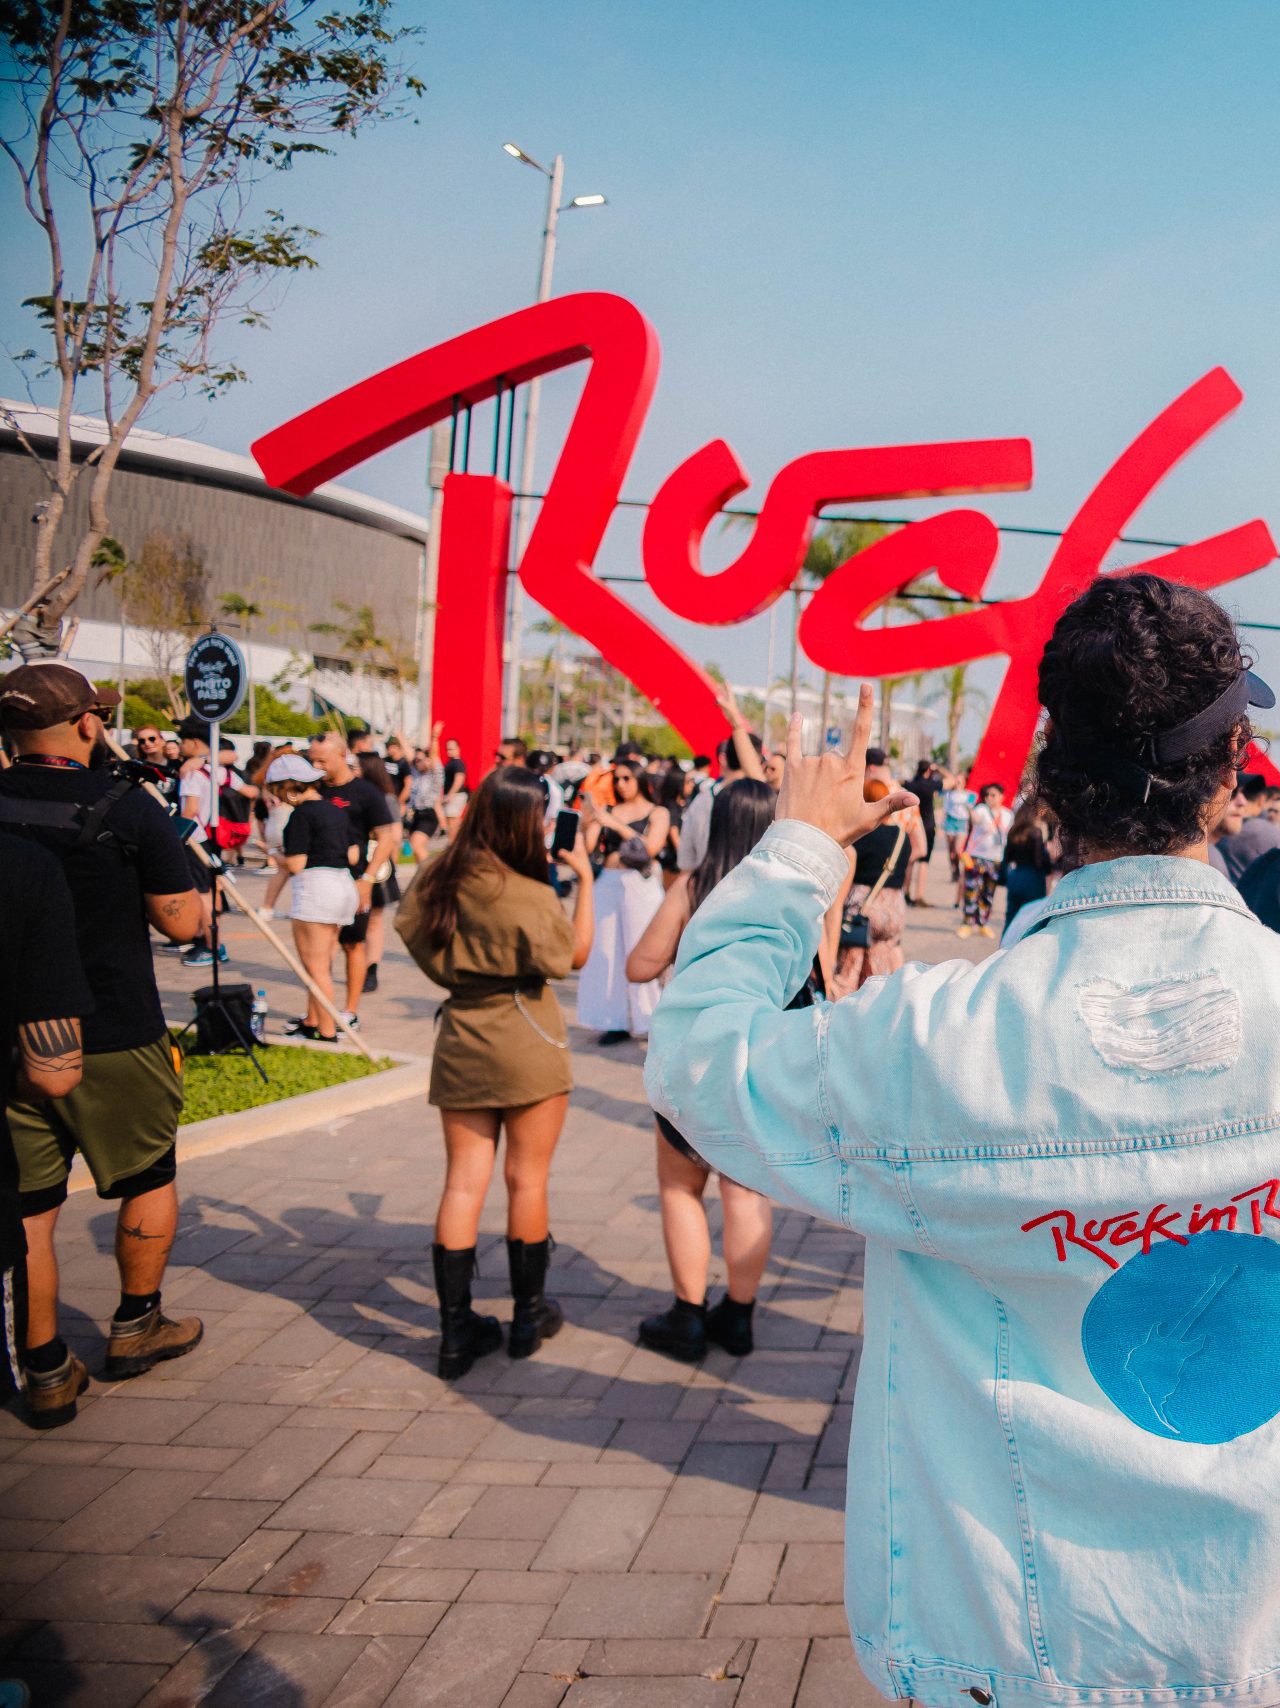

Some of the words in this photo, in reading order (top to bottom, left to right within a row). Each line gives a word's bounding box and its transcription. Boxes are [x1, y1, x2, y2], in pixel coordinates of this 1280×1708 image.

[193, 677, 233, 690] PHOTO
[197, 689, 227, 700] PASS
[1021, 1203, 1189, 1270] Rock
[1187, 1203, 1238, 1234] in
